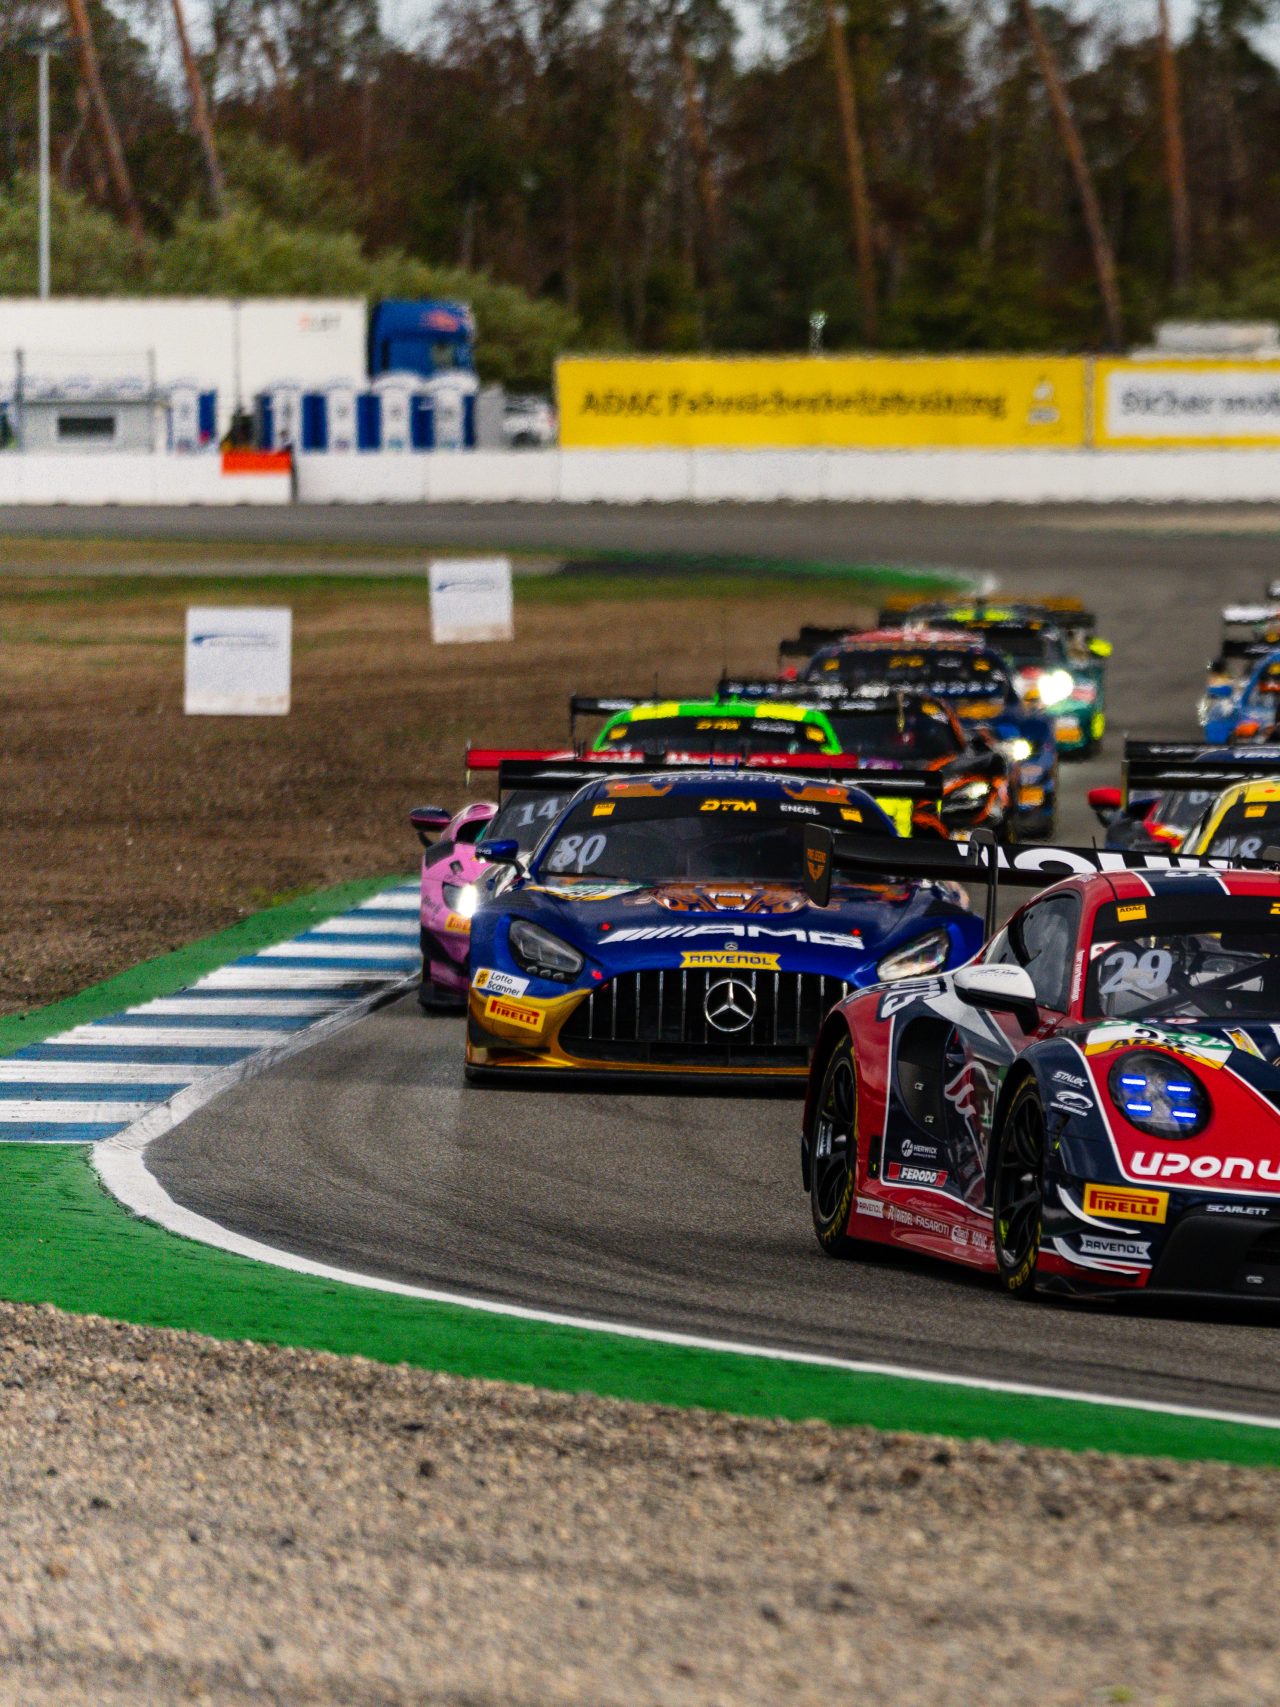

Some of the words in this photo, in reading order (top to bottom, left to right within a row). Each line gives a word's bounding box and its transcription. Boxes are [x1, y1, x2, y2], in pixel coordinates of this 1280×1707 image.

[517, 796, 560, 828] 14
[700, 800, 757, 813] DTM
[780, 804, 821, 817] ENGEL
[551, 834, 607, 871] 80
[1119, 906, 1145, 914] ADAC
[680, 925, 866, 950] AMG
[689, 955, 773, 966] RAVENOL
[491, 971, 513, 985] Lotto
[1099, 949, 1173, 994] 29
[487, 981, 521, 997] Scanner
[489, 999, 540, 1026] PIRELLI
[913, 1144, 938, 1155] HERWICK
[900, 1167, 937, 1183] FERODO
[1089, 1190, 1160, 1217] PIRELLI
[1206, 1204, 1270, 1216] SCARLETT
[1085, 1238, 1145, 1255] RAVENOL
